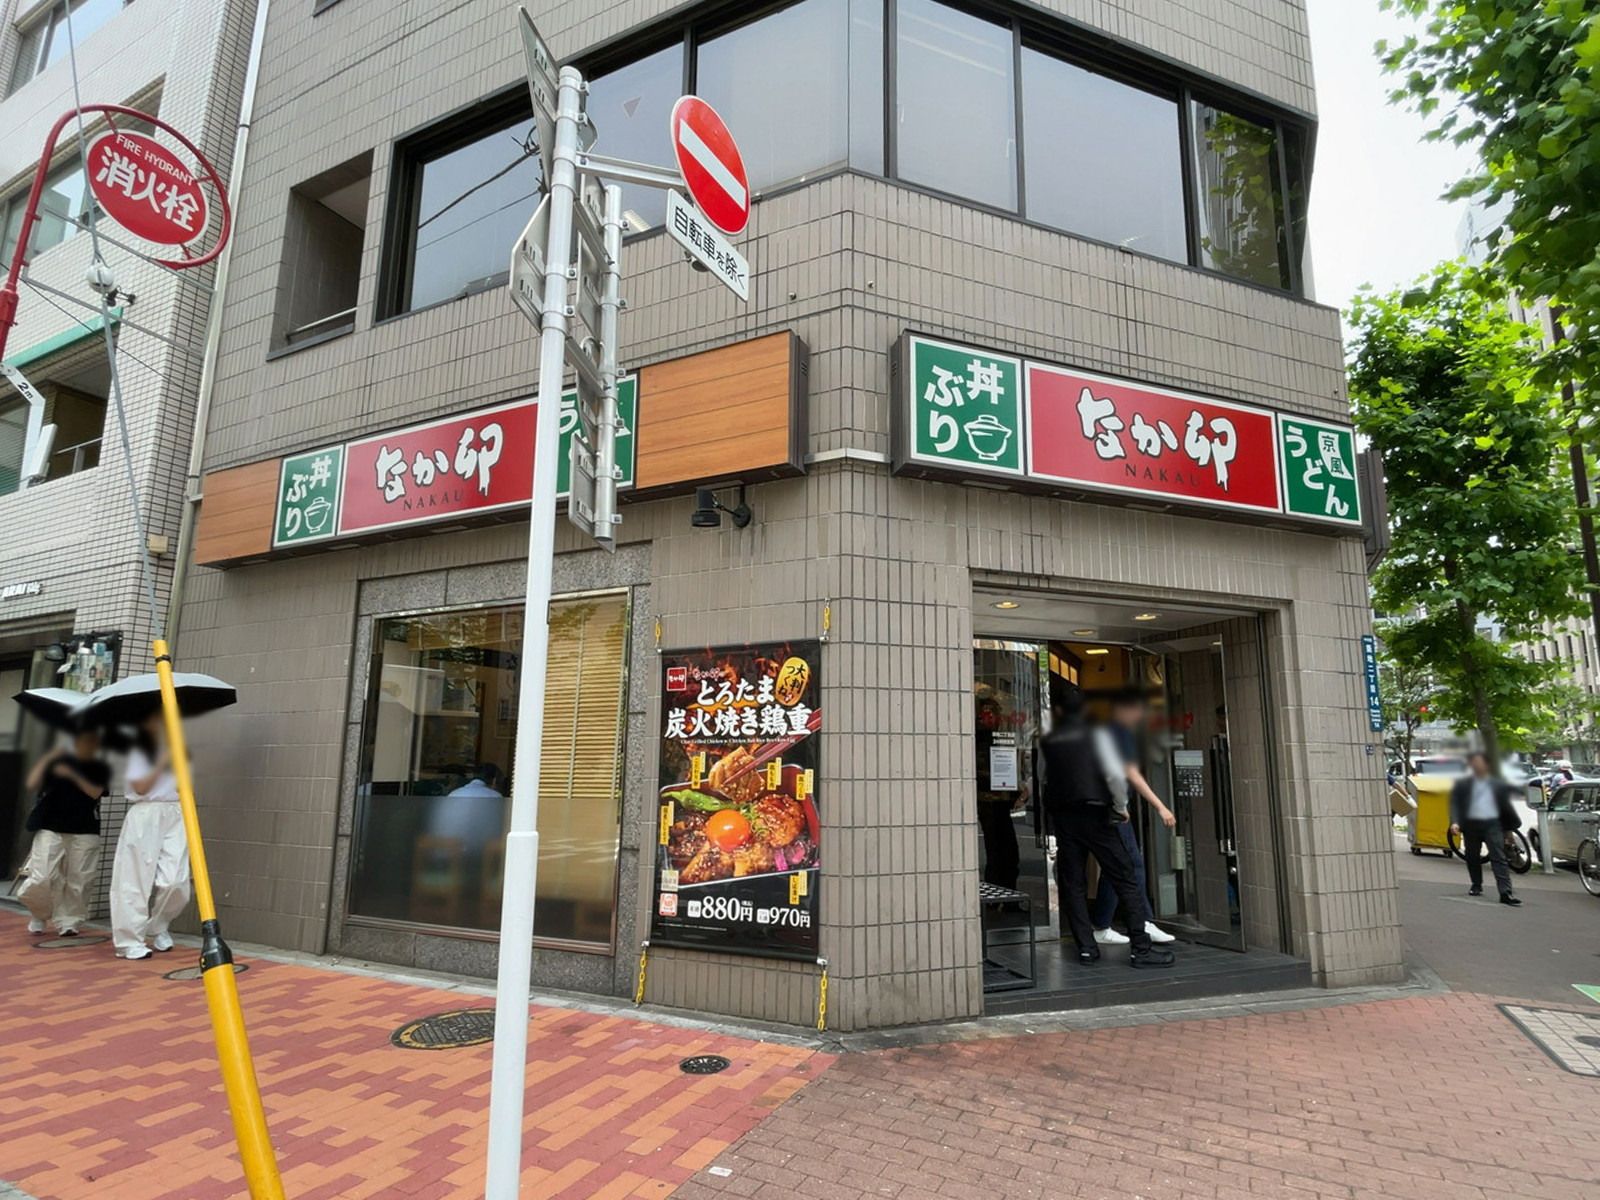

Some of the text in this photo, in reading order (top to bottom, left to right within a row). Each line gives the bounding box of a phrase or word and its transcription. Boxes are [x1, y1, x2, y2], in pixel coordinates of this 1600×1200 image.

[116, 134, 194, 186] FIRE HYDRANT
[95, 145, 200, 232] 消火栓
[674, 205, 745, 290] 自転車を除く
[17, 381, 34, 400] 2m
[1075, 386, 1238, 493] なか卯
[1321, 434, 1345, 476] 京風
[375, 422, 504, 504] なか卯
[1124, 462, 1201, 488] NAKAU
[1285, 424, 1350, 517] うどん
[402, 488, 464, 512] NAKAU
[696, 674, 775, 706] とろたま
[664, 702, 813, 739] 炭火焼き鶏重
[701, 895, 753, 922] 880円
[769, 906, 811, 928] 970円
